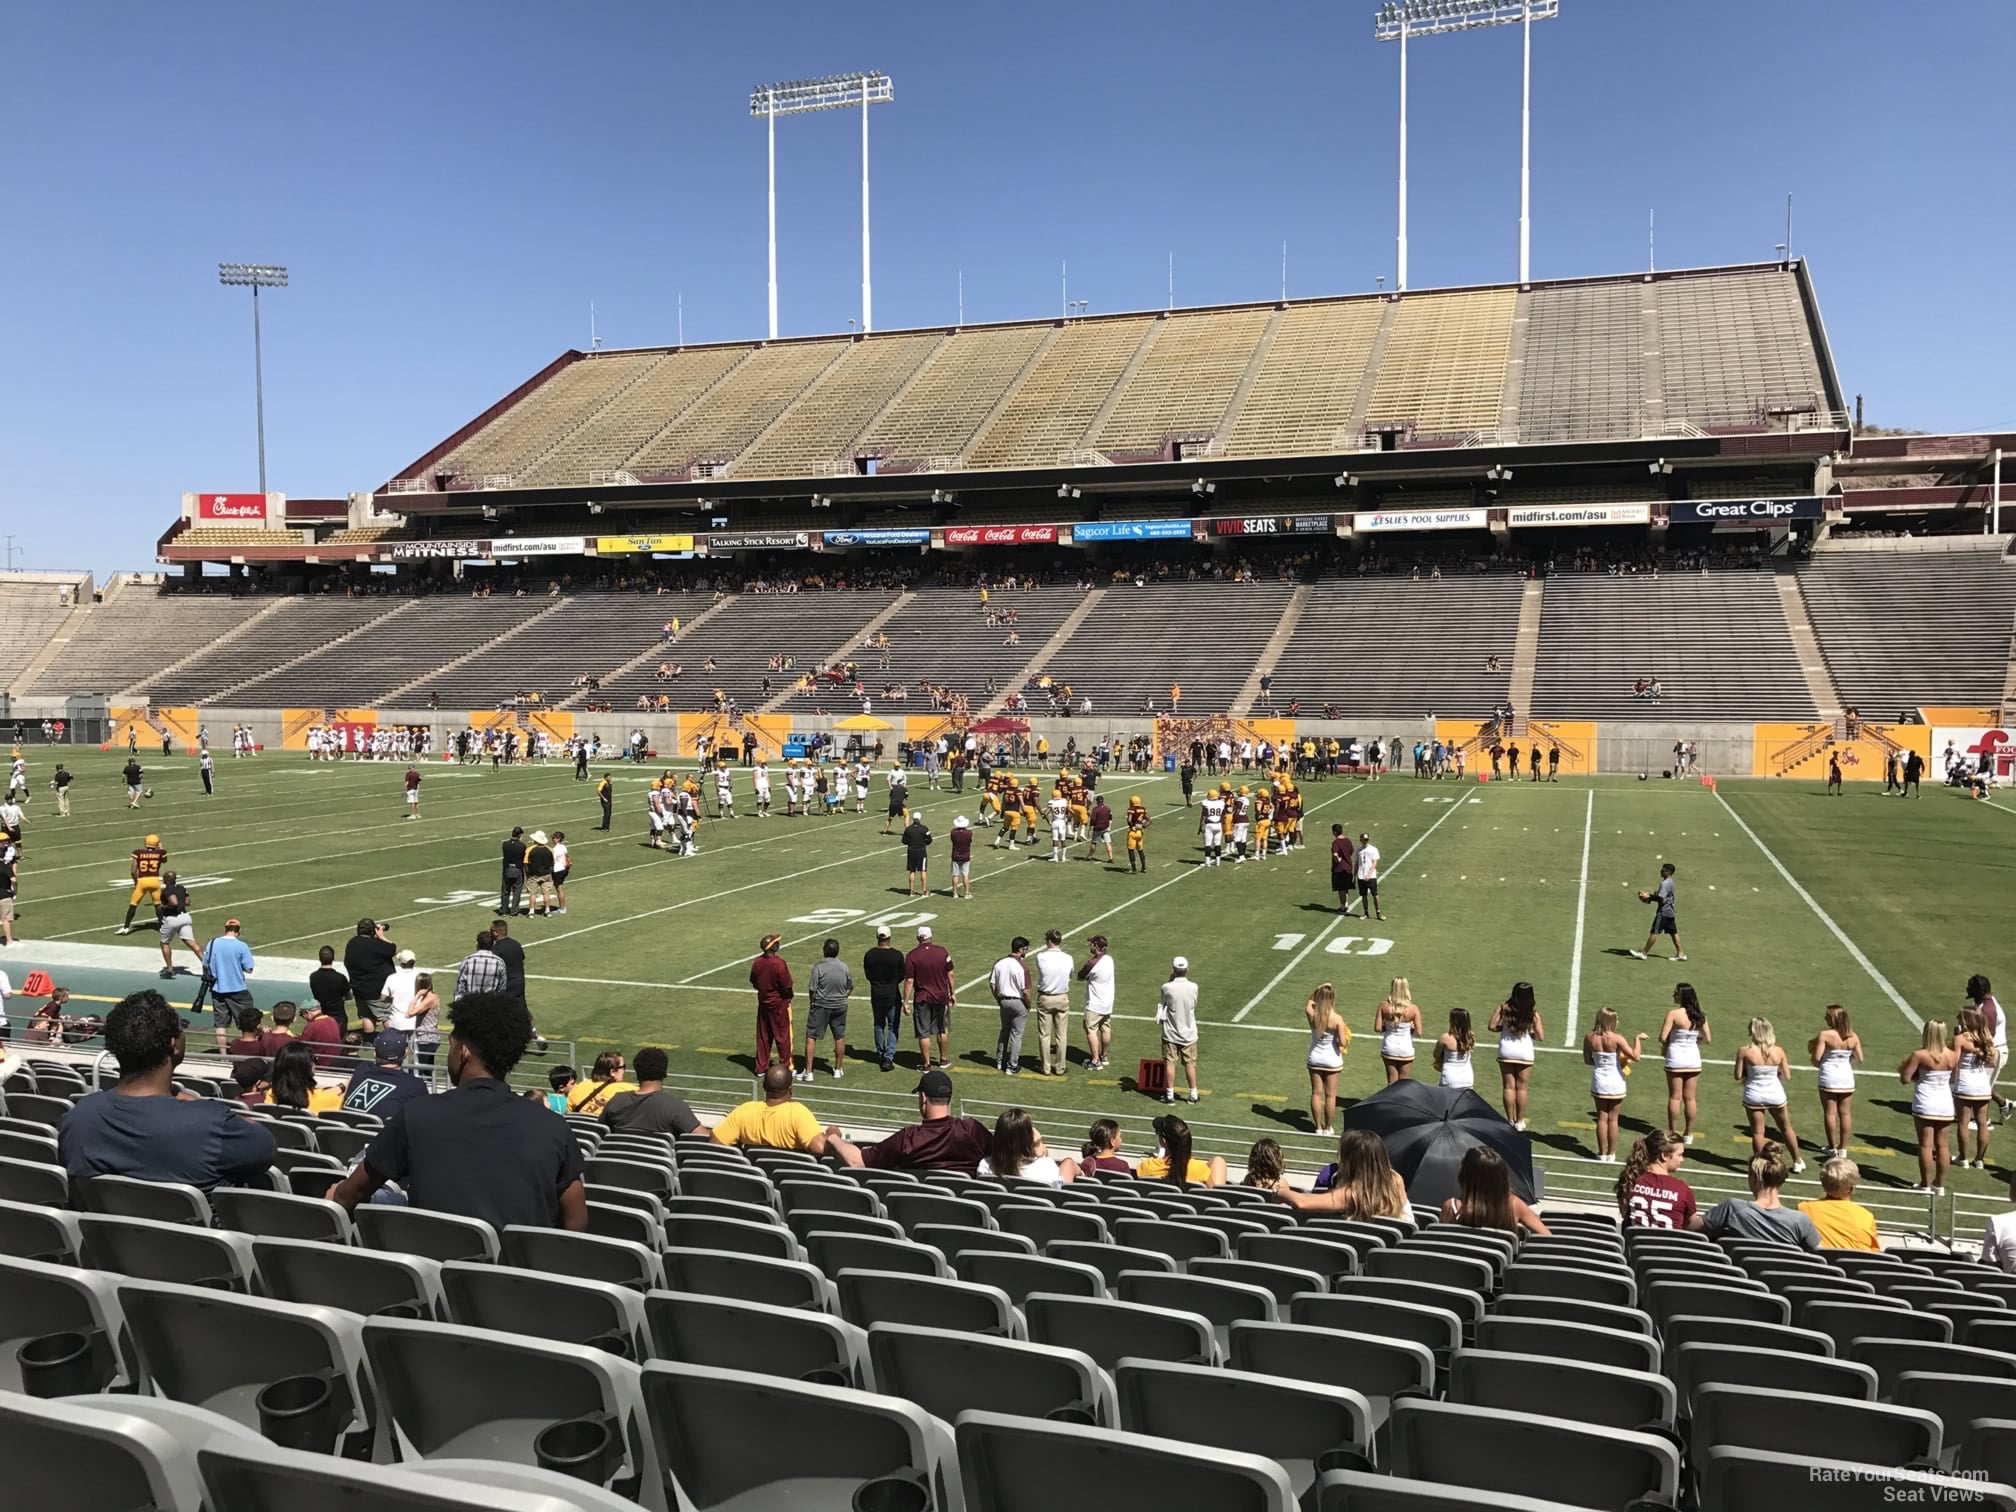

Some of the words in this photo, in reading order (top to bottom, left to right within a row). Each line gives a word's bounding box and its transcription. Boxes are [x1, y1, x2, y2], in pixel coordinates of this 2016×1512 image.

[1512, 507, 1607, 523] midfirst.com/asu
[1696, 502, 1747, 516] Great
[1750, 500, 1797, 515] Clips
[1411, 514, 1433, 524] POOL
[1435, 513, 1470, 523] SUPPLIES
[1074, 525, 1109, 539] Sagicor
[1112, 524, 1131, 535] Life
[405, 541, 479, 550] MOUNTAINSIDE
[405, 548, 479, 557] FITNESS
[493, 541, 557, 552] midfirst.com/asu
[1209, 808, 1221, 817] 98
[785, 908, 939, 928] 20
[1271, 933, 1395, 956] 10
[23, 973, 43, 993] 30
[1143, 1062, 1166, 1089] 10
[1631, 1184, 1679, 1202] CCOLLUM
